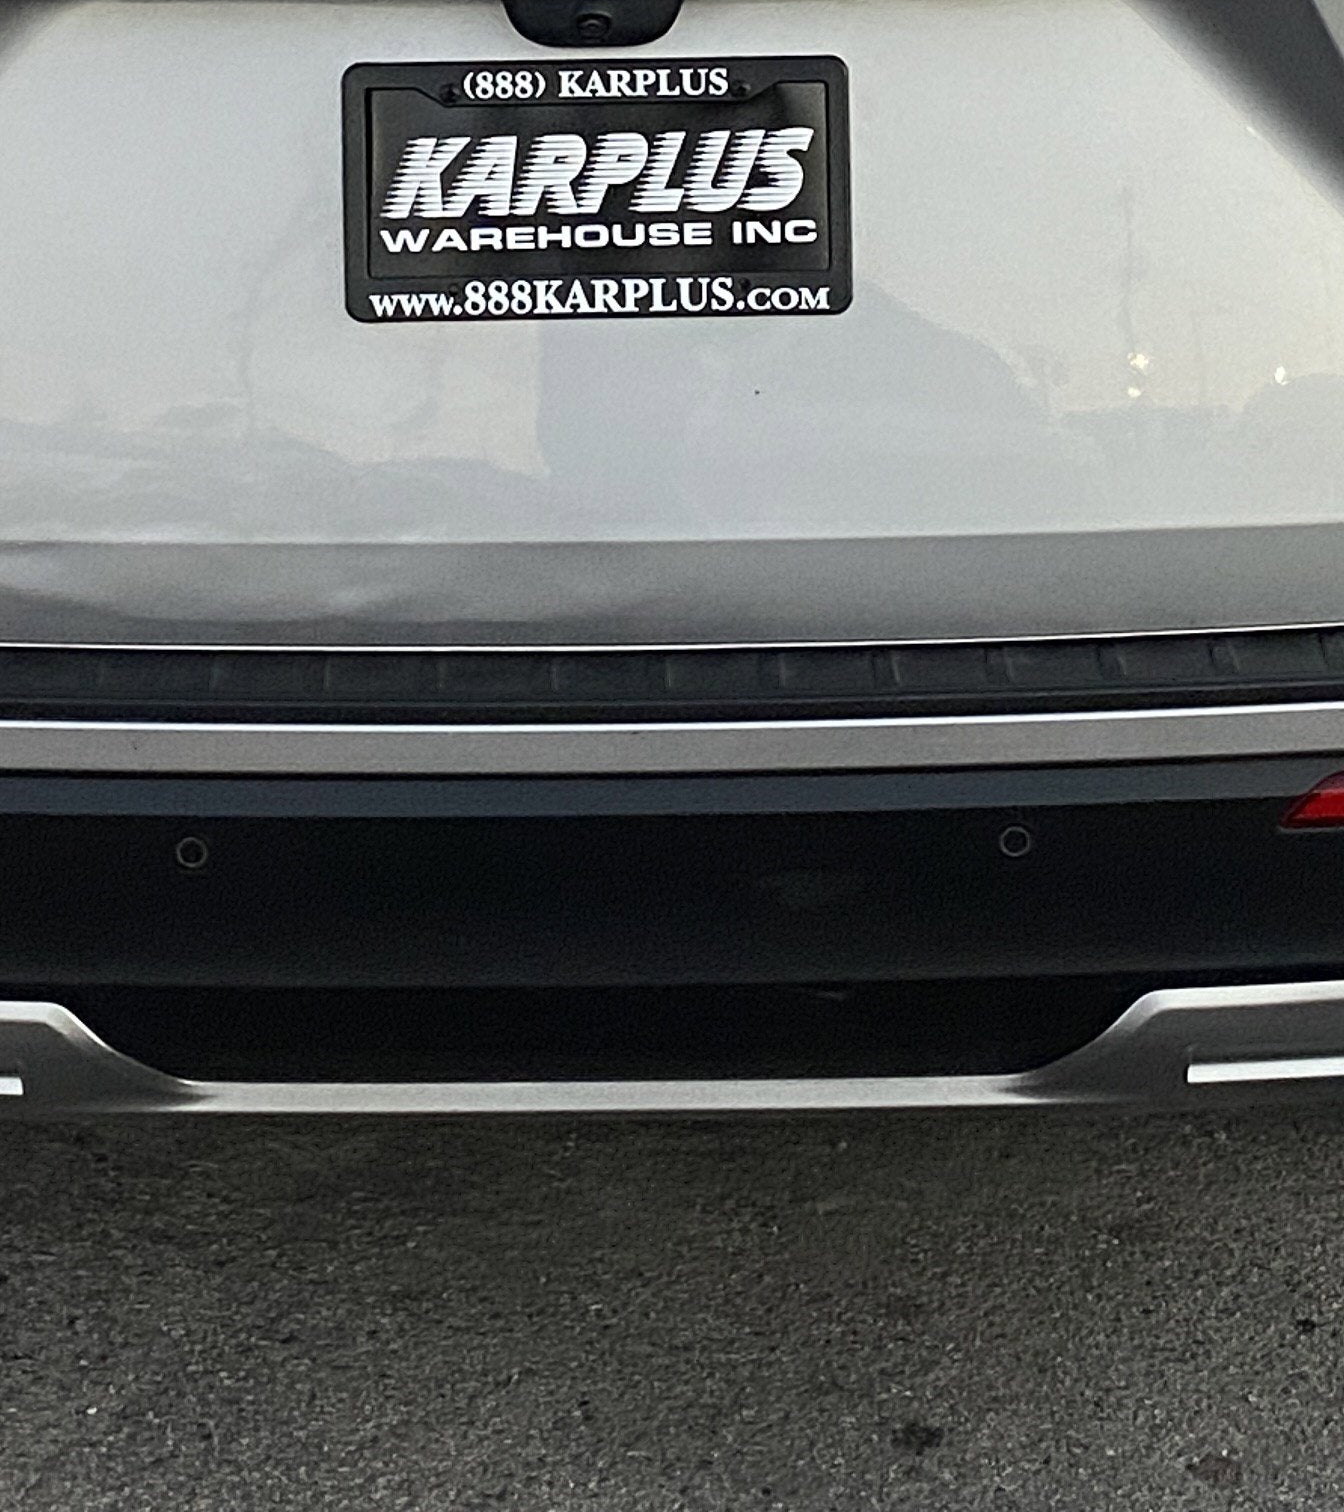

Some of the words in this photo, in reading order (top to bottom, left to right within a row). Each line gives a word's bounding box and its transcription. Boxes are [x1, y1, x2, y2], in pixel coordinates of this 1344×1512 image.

[463, 70, 546, 100] (888)
[558, 68, 729, 97] KARPLUS
[380, 126, 815, 219] KARPLUS
[380, 224, 712, 253] WAREHOUSE
[732, 219, 818, 245] INC
